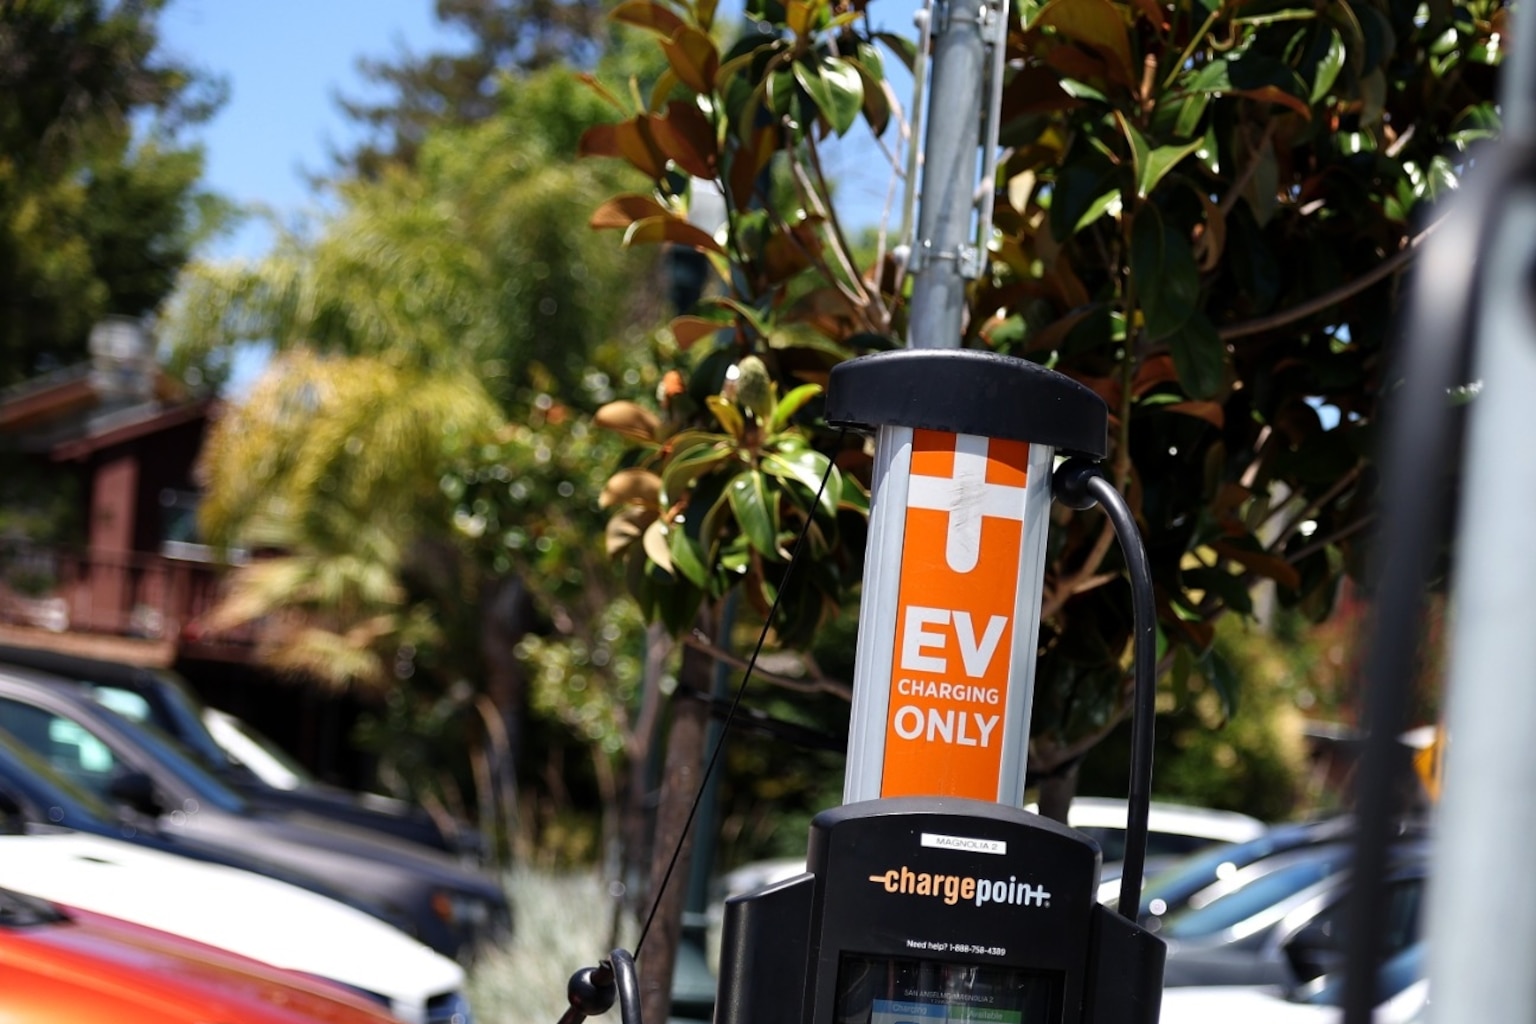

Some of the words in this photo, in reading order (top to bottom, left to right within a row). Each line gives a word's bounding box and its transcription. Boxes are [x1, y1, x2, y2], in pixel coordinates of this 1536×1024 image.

[901, 605, 1008, 678] EV
[898, 678, 999, 704] CHARGING
[894, 705, 1000, 748] ONLY
[936, 837, 990, 850] MAGNOLIA
[907, 939, 926, 949] Need
[927, 940, 948, 951] help?
